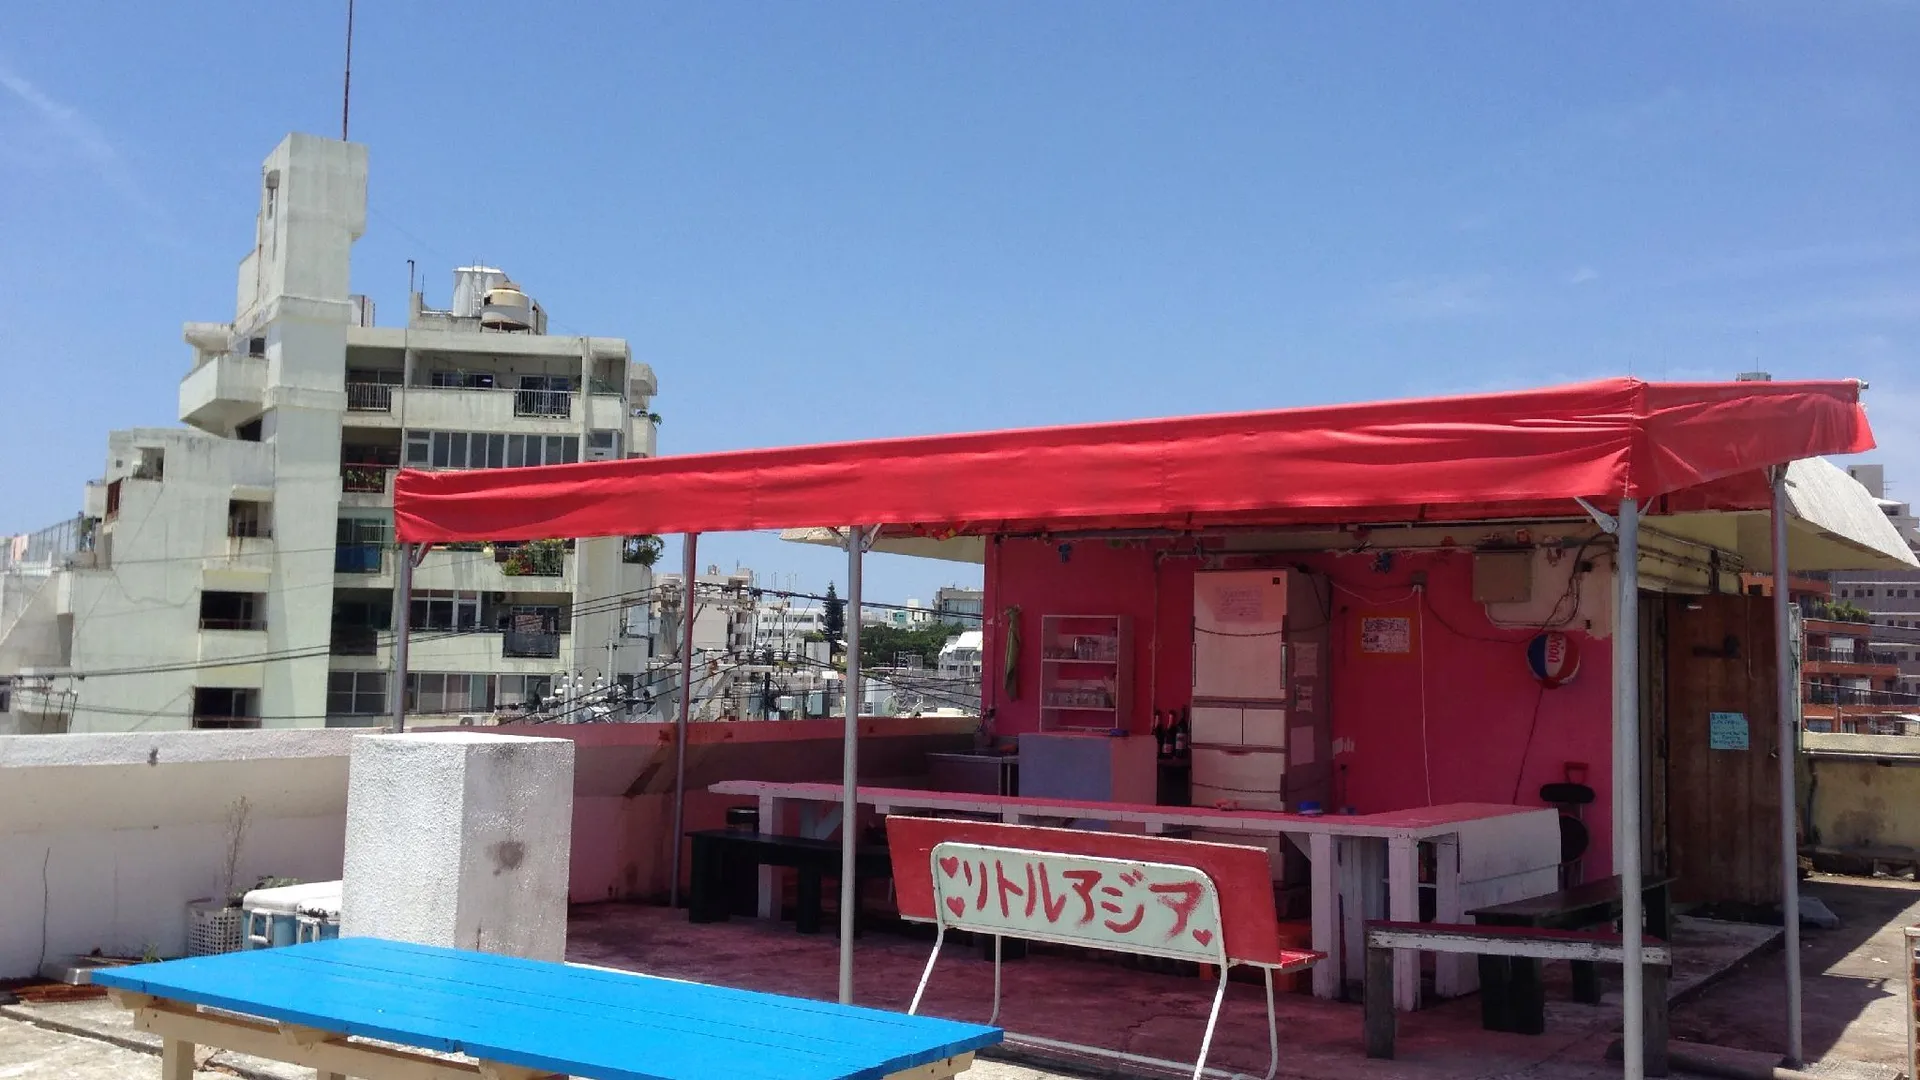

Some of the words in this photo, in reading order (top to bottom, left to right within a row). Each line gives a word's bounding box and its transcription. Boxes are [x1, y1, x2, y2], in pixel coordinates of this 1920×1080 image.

[963, 859, 1204, 941] リトルアジア
